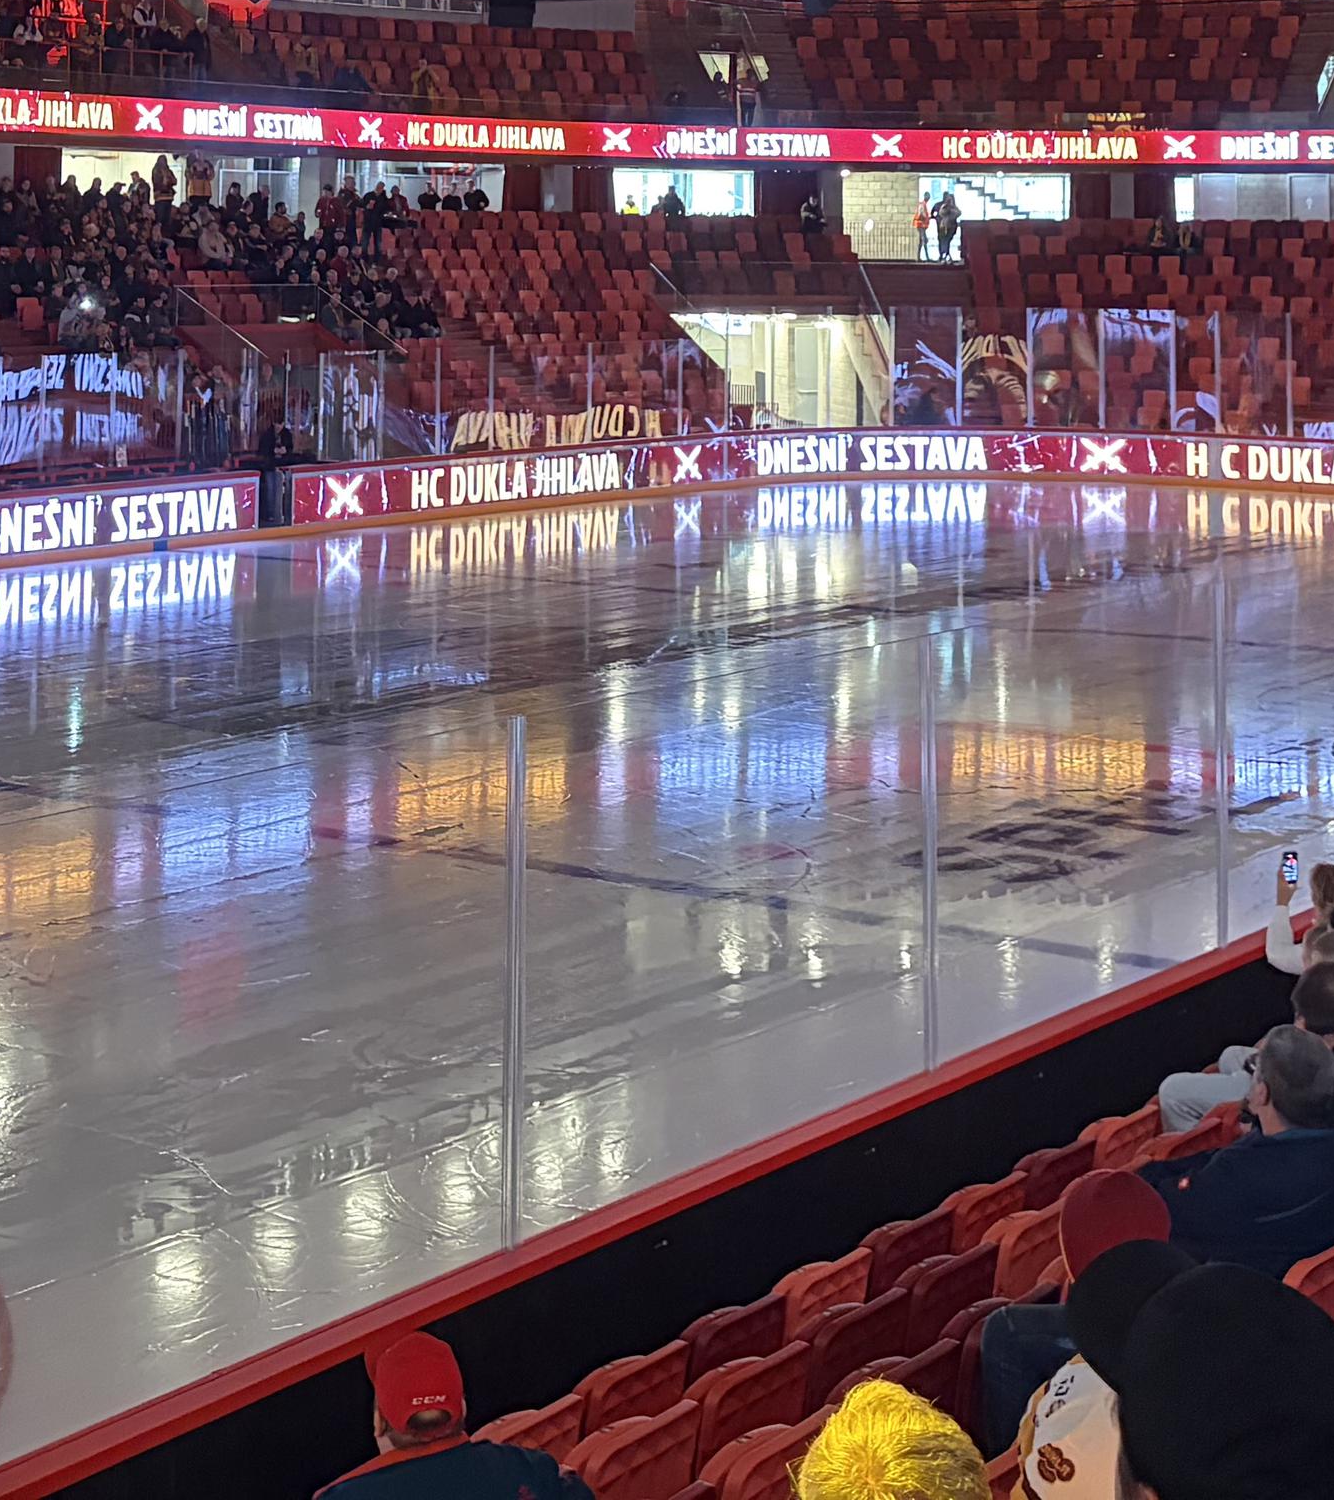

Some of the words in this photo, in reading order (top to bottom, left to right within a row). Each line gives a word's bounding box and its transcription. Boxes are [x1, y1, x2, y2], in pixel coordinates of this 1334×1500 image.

[33, 100, 113, 130] JIHLAVA
[183, 106, 247, 136] DNEŠNÍ
[254, 112, 323, 141] SESTAVA
[407, 122, 429, 145] HC
[434, 123, 489, 148] DUKLA
[493, 126, 565, 150] JIHLAVA
[666, 128, 737, 156] DNEŠNÍ
[746, 134, 830, 157] SESTAVA
[943, 136, 971, 159] HC
[976, 134, 1045, 160] DUKLA
[1048, 137, 1138, 159] JIHLAVA
[1221, 131, 1299, 160] DNEŠNÍ
[860, 435, 987, 471] SESTAVA
[412, 469, 444, 509] HC
[450, 460, 527, 505] DUKLA
[532, 450, 620, 496] JIHLAVA
[111, 487, 237, 543] SESTAVA
